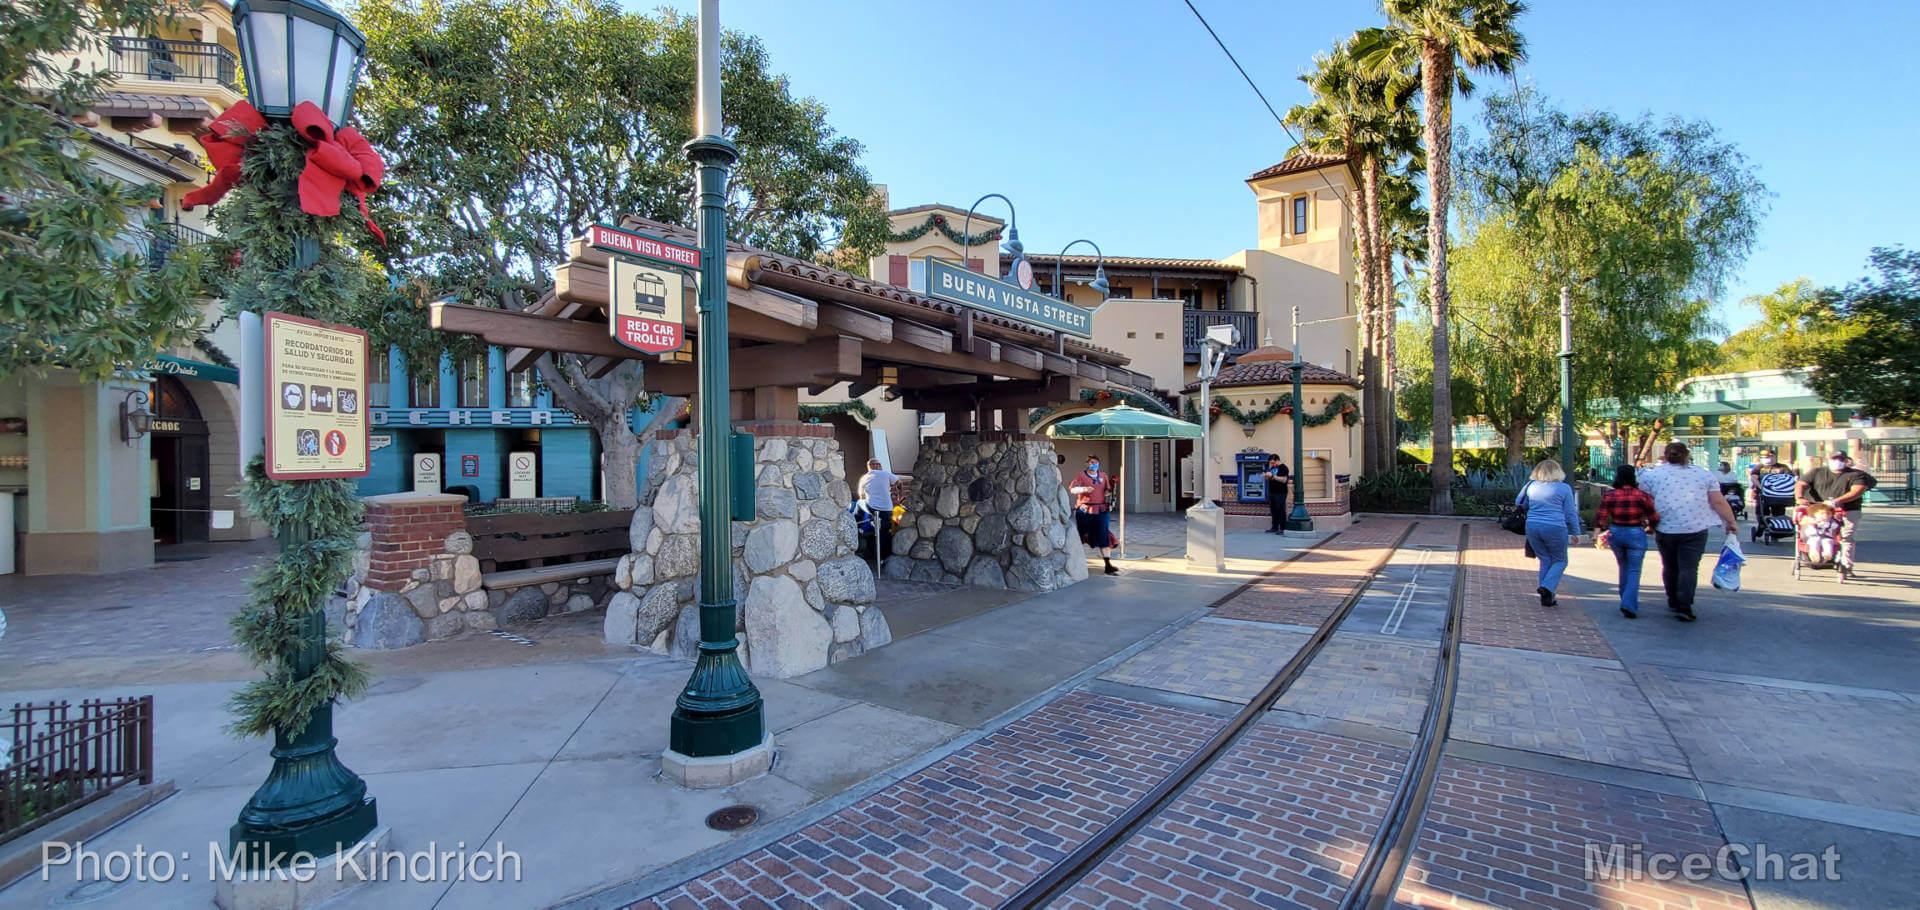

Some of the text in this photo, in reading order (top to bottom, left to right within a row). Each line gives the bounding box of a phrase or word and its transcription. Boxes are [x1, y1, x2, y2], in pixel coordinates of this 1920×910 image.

[600, 230, 695, 264] BUENA VISTA STREET
[942, 271, 1086, 328] BUENA VISTA STREET
[627, 320, 674, 336] RED CAR
[312, 332, 344, 342] IMPORTANTE
[626, 331, 675, 347] TROLLEY
[284, 348, 309, 358] SALUD
[317, 352, 355, 364] SEGURIDAD
[285, 339, 353, 357] RECORDATORIOS DE
[143, 359, 165, 371] Cold
[165, 361, 198, 376] Drinks
